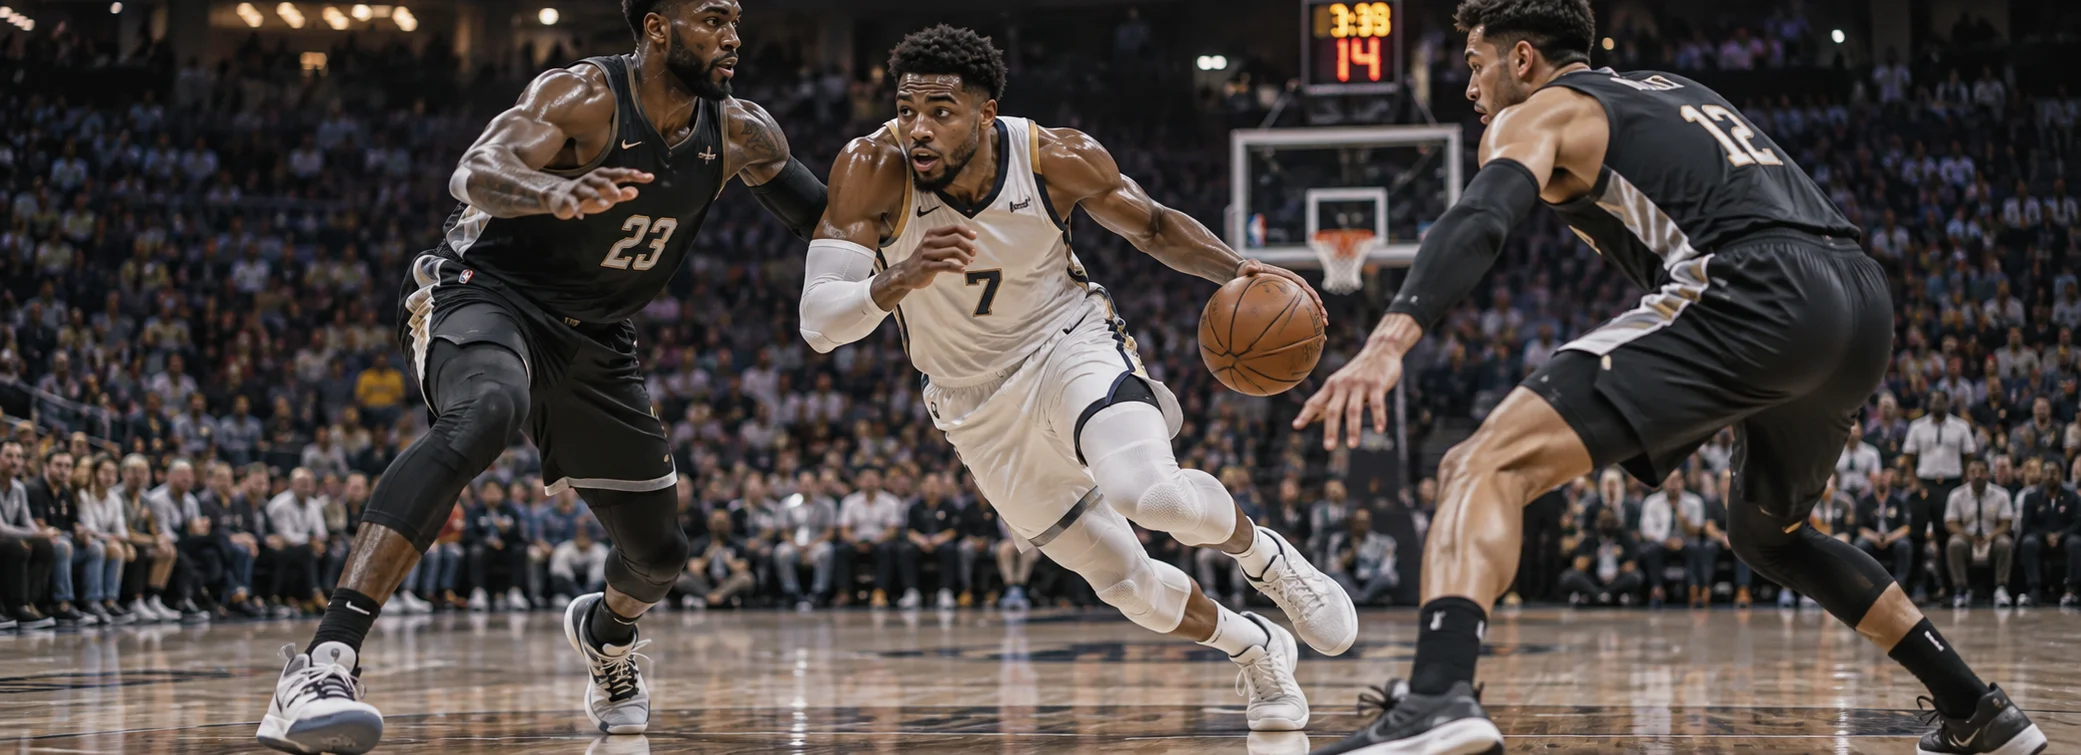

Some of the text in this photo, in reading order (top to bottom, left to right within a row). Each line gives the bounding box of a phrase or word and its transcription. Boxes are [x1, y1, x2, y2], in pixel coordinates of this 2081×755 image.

[1329, 2, 1391, 38] 3:39
[1337, 36, 1382, 82] 14
[1680, 104, 1784, 167] 12
[600, 214, 678, 271] 23
[964, 268, 1003, 317] 7
